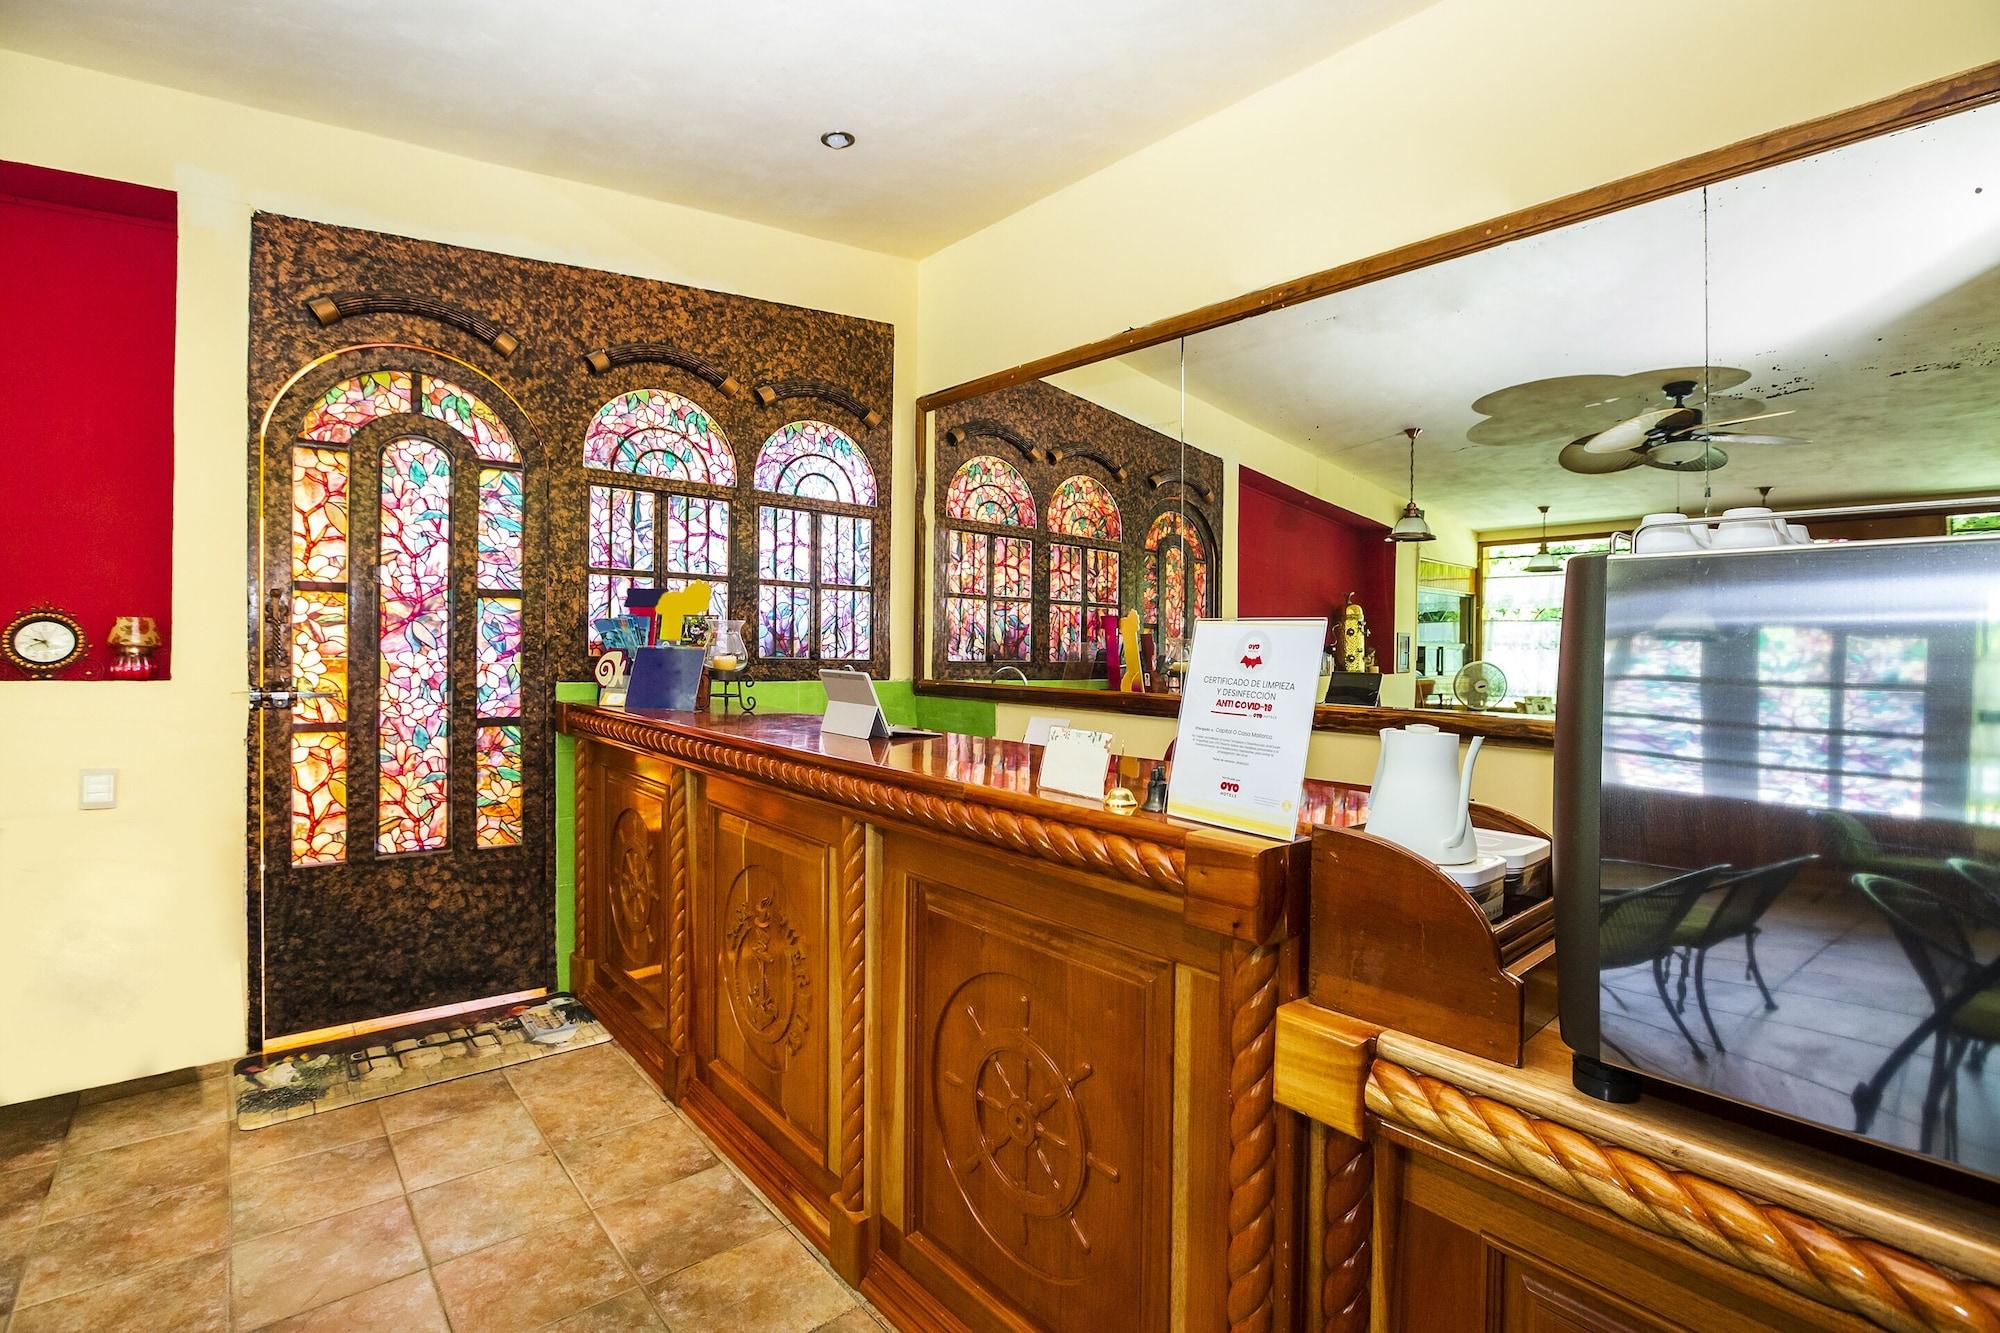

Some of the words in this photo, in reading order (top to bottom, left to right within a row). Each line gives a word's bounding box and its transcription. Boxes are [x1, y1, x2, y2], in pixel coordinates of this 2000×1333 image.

[1203, 675, 1250, 687] CERTIFICADO
[1250, 679, 1261, 688] DE
[1262, 680, 1295, 691] LIMPIEZA
[1216, 687, 1222, 696] Y
[1215, 699, 1234, 708] ANTI
[1234, 700, 1273, 712] COVID-19
[1220, 781, 1240, 793] OYO
